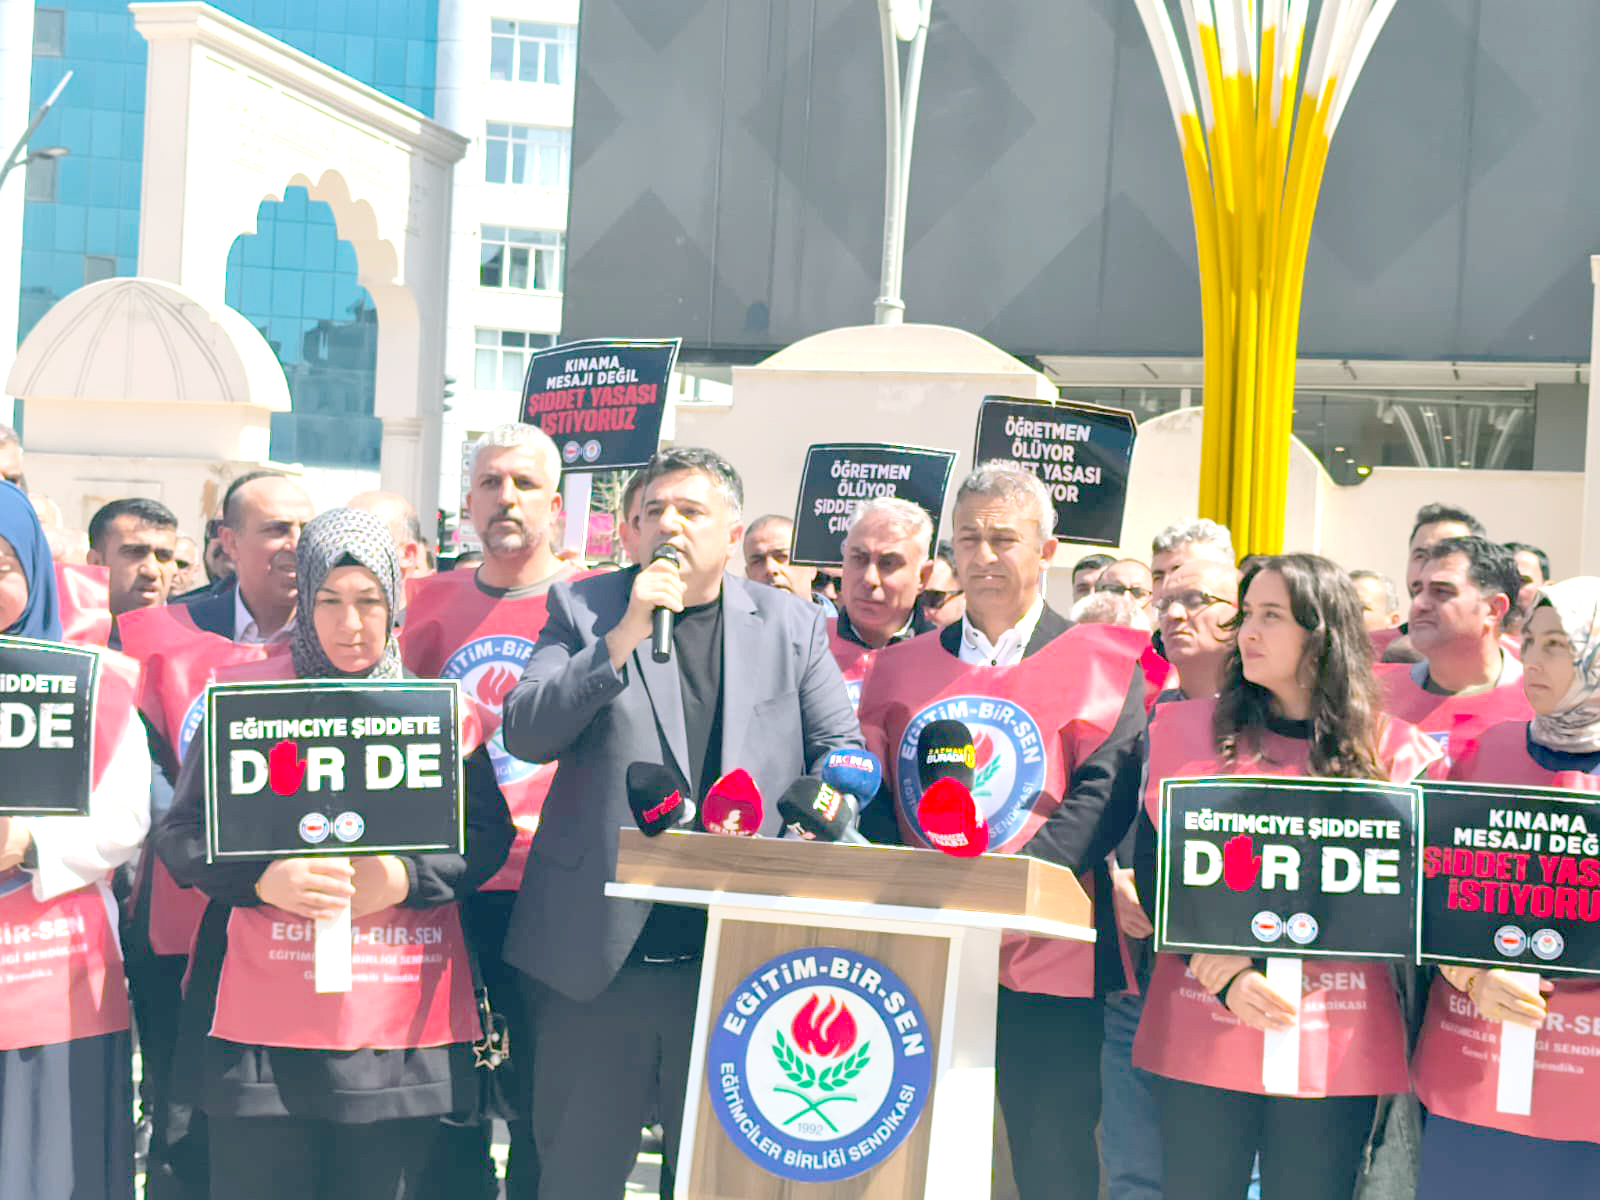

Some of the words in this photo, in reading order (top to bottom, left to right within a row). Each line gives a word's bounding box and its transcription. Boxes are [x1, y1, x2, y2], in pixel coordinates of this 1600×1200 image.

[565, 356, 620, 373] KINAMA
[546, 372, 592, 390] MESAJI
[597, 366, 639, 385] DEĞİL
[528, 388, 586, 416] ŞİDDET
[591, 384, 657, 408] YASASI
[540, 407, 638, 436] İSTİYORUZ
[1005, 416, 1091, 442] ÖĞRETMEN
[1012, 440, 1074, 462] ÖLÜYOR
[830, 460, 911, 480] ÖĞRETMEN
[1042, 463, 1101, 484] YASASI
[837, 480, 896, 497] ÖLÜYOR
[1048, 483, 1078, 502] YOR
[814, 498, 854, 516] ŞİDDE
[828, 516, 850, 534] ÇIK
[0, 674, 76, 693] İDDETE
[0, 702, 74, 748] DE
[230, 717, 347, 740] EĞİTİMCİYE
[351, 716, 440, 739] ŞİDDETE
[366, 743, 442, 790] DE
[1184, 808, 1304, 835] EĞİTİMCİYE
[1308, 817, 1400, 840] ŞİDDETE
[1489, 809, 1587, 834] KINAMA
[1454, 827, 1541, 851] MESAJI
[1549, 832, 1600, 856] DEĞ
[1321, 846, 1400, 894] DE
[1424, 845, 1531, 878] ŞİDDET
[1539, 854, 1600, 888] YAS
[1447, 878, 1600, 923] İSTİYORU
[723, 956, 925, 1056] EĞİTİM-BİR-SEN
[721, 1062, 781, 1160] EĞİTİMCİLER
[783, 1148, 846, 1169] BİRLİĞİ
[850, 1085, 916, 1161] SENDİKASI
[797, 1122, 823, 1135] 1992
